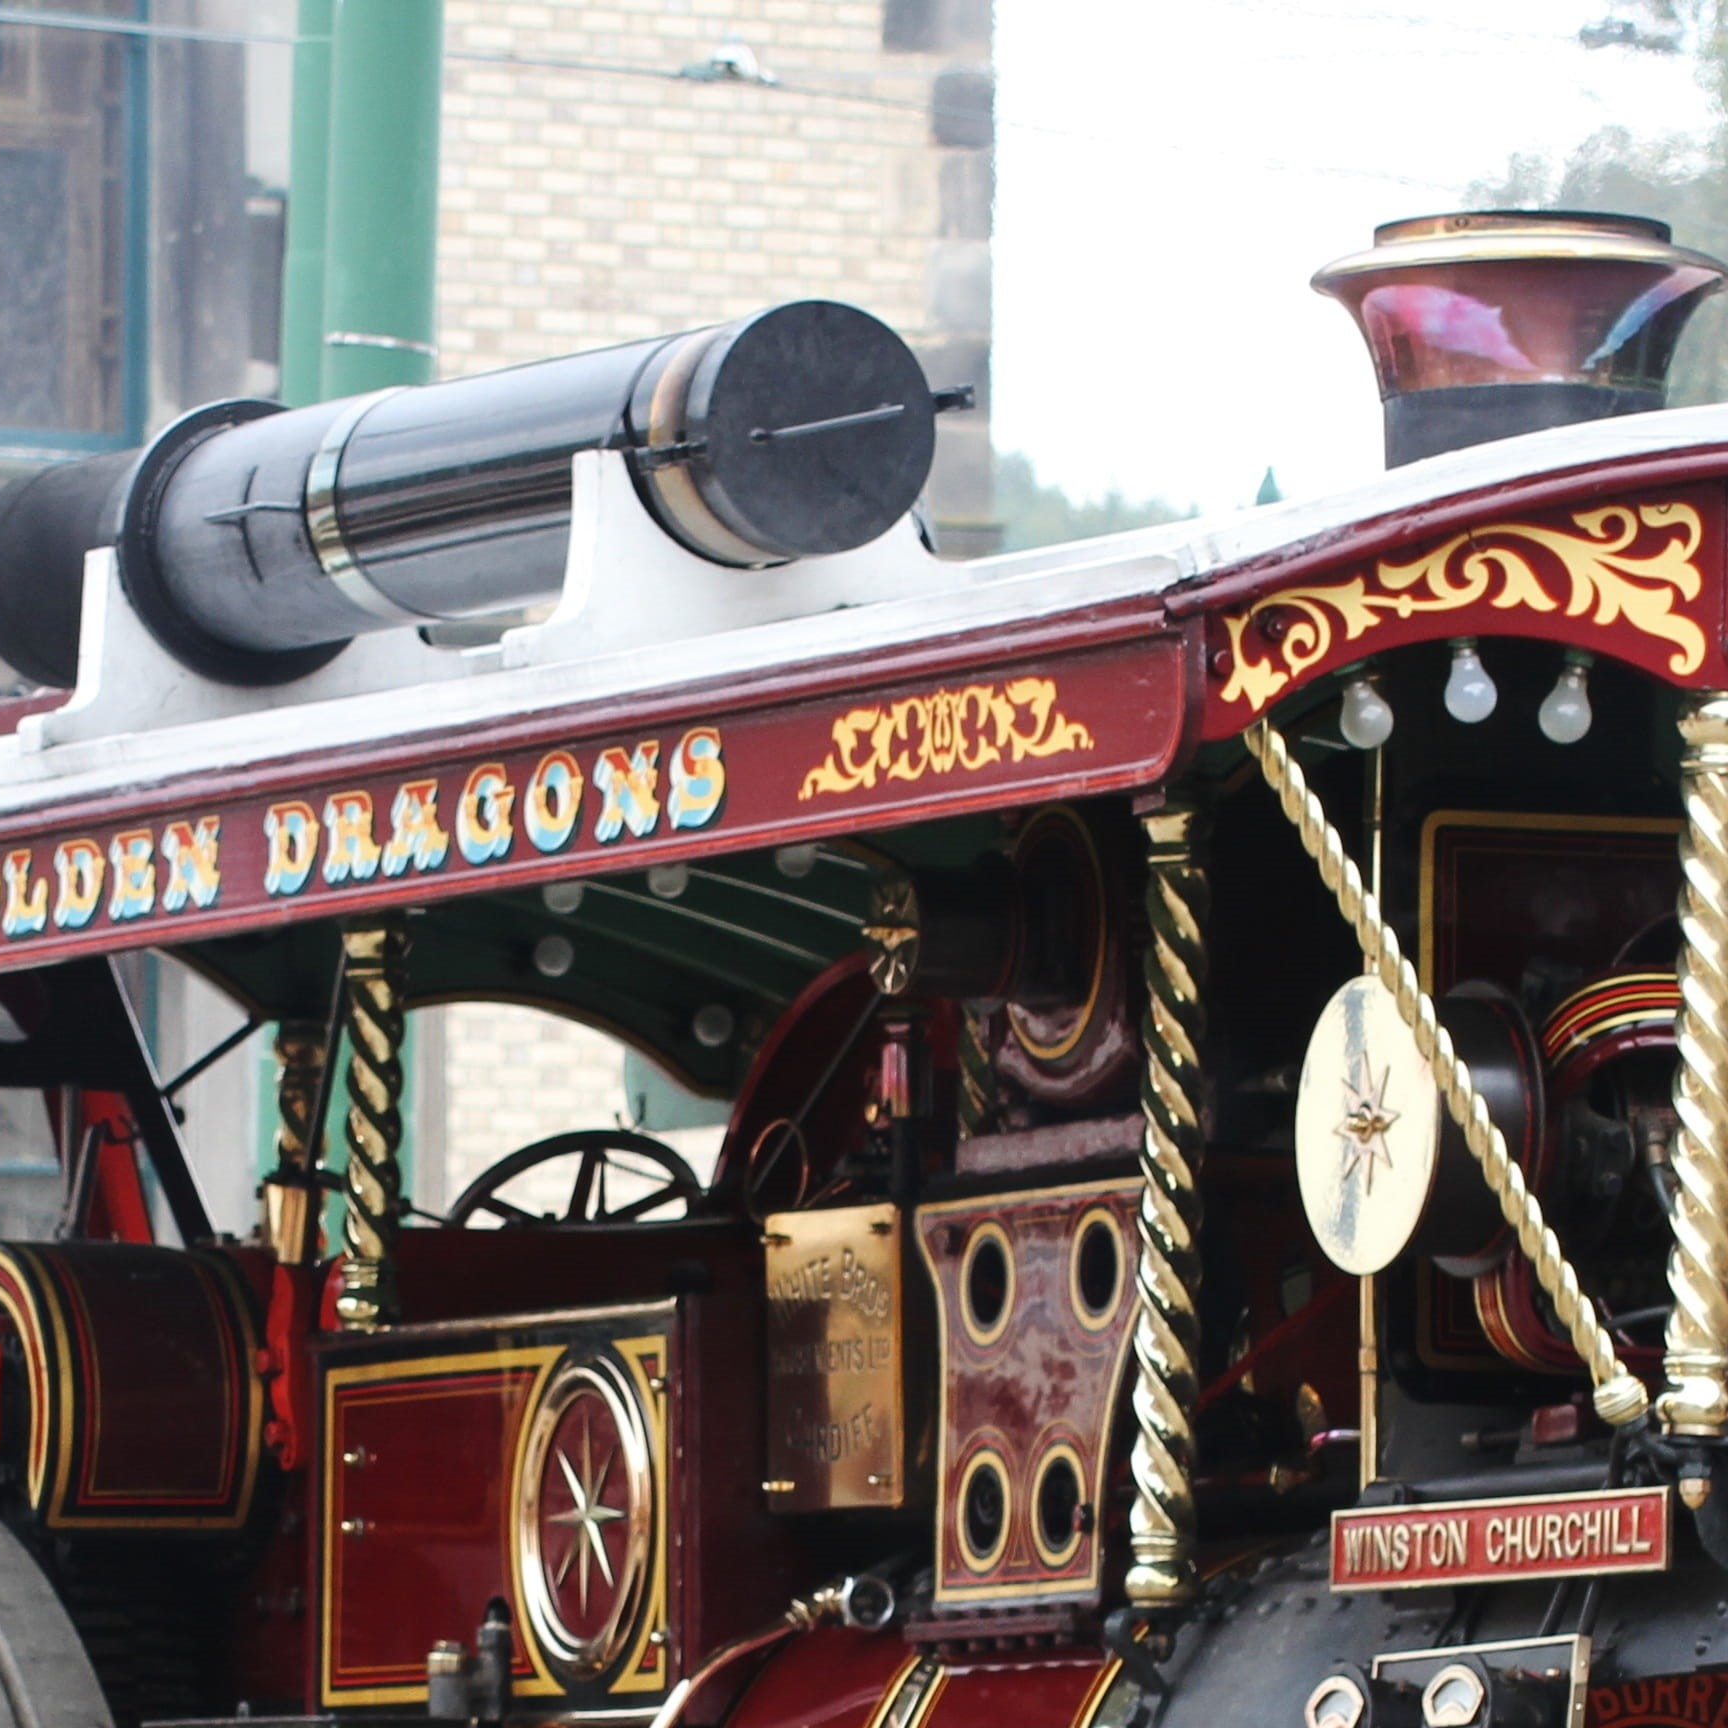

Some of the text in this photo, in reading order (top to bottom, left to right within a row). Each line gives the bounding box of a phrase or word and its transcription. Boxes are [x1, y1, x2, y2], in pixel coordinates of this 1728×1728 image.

[263, 726, 729, 896] DRAGONS
[786, 1402, 874, 1463] RDIFF
[1342, 1505, 1653, 1575] WINSTON CHURCHILL
